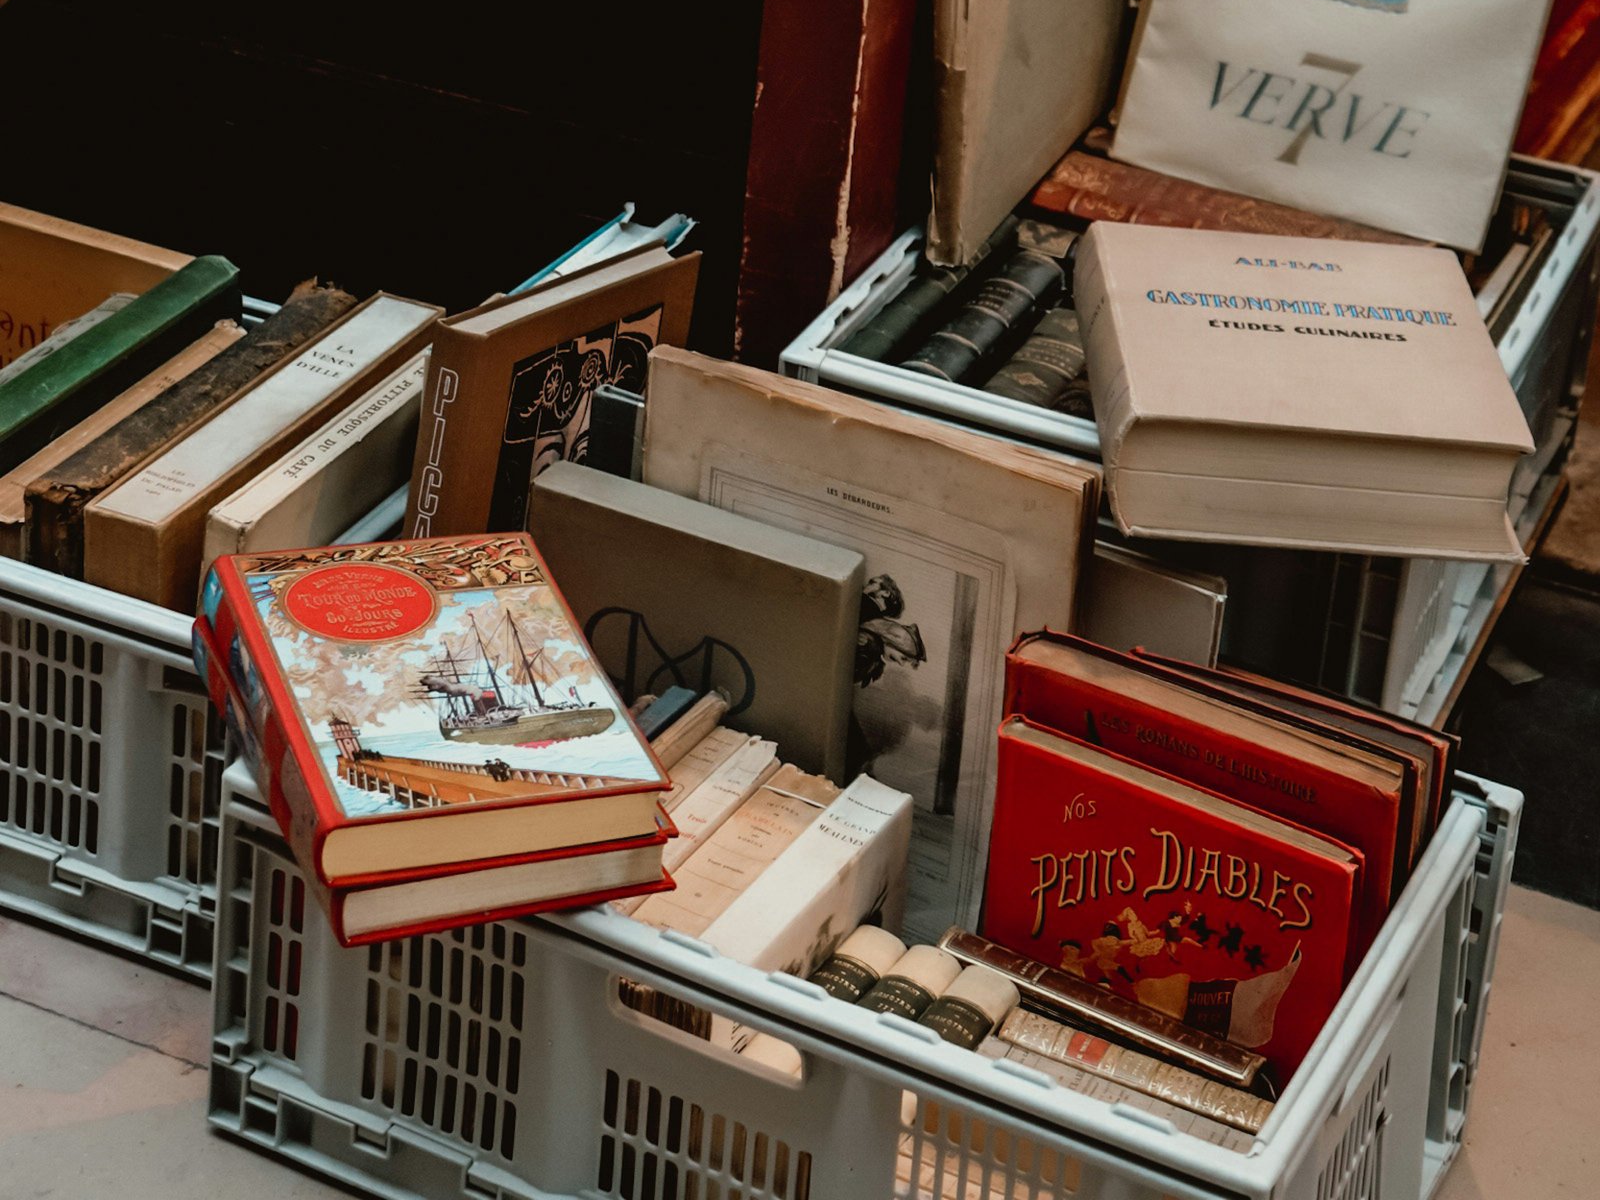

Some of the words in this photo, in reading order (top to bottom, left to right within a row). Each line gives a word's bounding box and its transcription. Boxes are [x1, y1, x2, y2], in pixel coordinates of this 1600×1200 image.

[1206, 61, 1432, 160] VERVE
[1235, 256, 1342, 272] ALI-BAB
[1146, 289, 1330, 317] GASTRONOMIE
[1335, 302, 1457, 327] PRATIQUE
[1294, 325, 1408, 343] CULINAIRES
[337, 380, 413, 436] PITTORESQUE
[318, 438, 337, 453] DU
[827, 487, 838, 497] LES
[1063, 793, 1097, 823] NOS
[1030, 846, 1135, 938] PETITS
[1143, 827, 1312, 930] DIABLES
